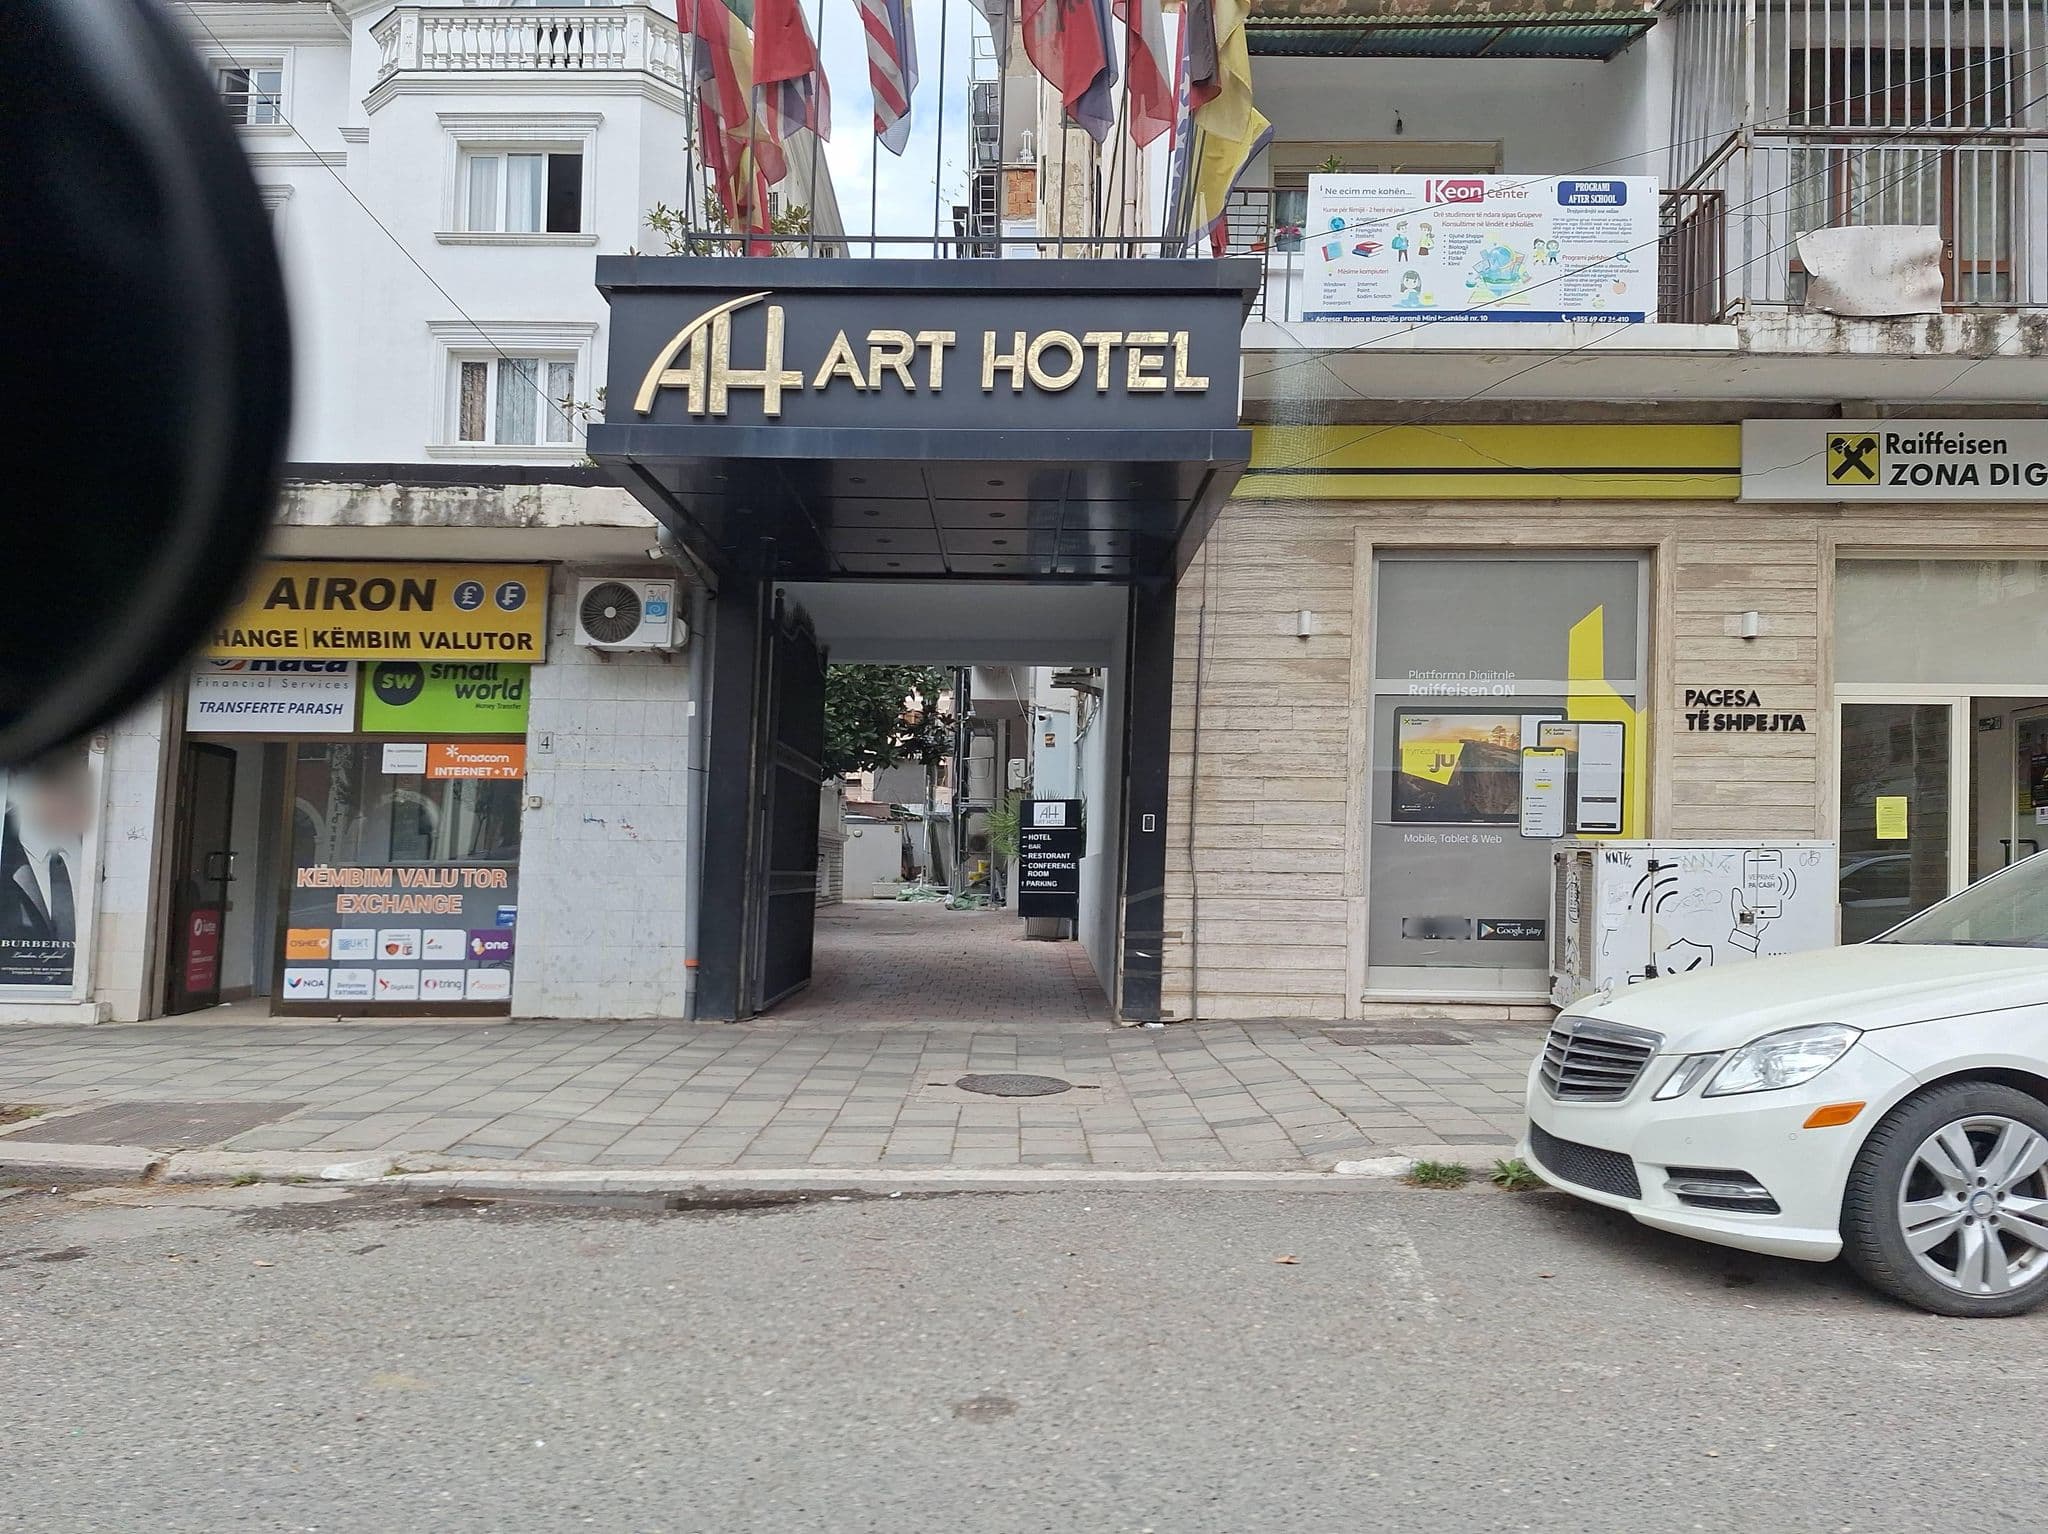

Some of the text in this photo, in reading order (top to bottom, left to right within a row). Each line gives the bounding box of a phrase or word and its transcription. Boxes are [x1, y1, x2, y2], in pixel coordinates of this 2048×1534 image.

[1325, 187, 1337, 195] Ne
[1339, 187, 1361, 195] ecim
[1429, 179, 1529, 203] Keon Center
[1575, 182, 1611, 192] PROGRAMI
[1568, 194, 1618, 204] AFTER SCHOOL
[812, 328, 1210, 392] ART HOTEL
[1885, 430, 2008, 454] Raiffeisen
[1888, 463, 1980, 486] ZONA
[263, 576, 437, 612] AIRON
[212, 626, 533, 650] HANGE KËMBIM VALUTOR
[430, 662, 498, 681] small
[1408, 669, 1466, 680] Platforma
[196, 677, 349, 689] Financial Services
[455, 678, 524, 701] world
[1409, 683, 1515, 696] Raiffeisen ON
[1685, 689, 1761, 707] PAGESA
[199, 701, 344, 715] TRANSFERTE PARASH
[1685, 709, 1806, 732] TË SHPEJTA
[540, 736, 550, 750] 4
[435, 767, 492, 776] INTERNET
[502, 767, 518, 777] TV
[1404, 833, 1502, 844] Mobile, Tablet & Web
[1028, 852, 1071, 860] RESTORANT
[1027, 862, 1076, 870] CONFERENCE
[297, 863, 393, 888] KËMBIM
[1026, 880, 1058, 888] PARKING
[336, 893, 464, 915] EXCHANGE
[1496, 926, 1543, 937] Google play
[1, 940, 77, 948] BURBERRY
[484, 940, 509, 950] one
[303, 979, 324, 987] NOA
[439, 980, 462, 990] tring
